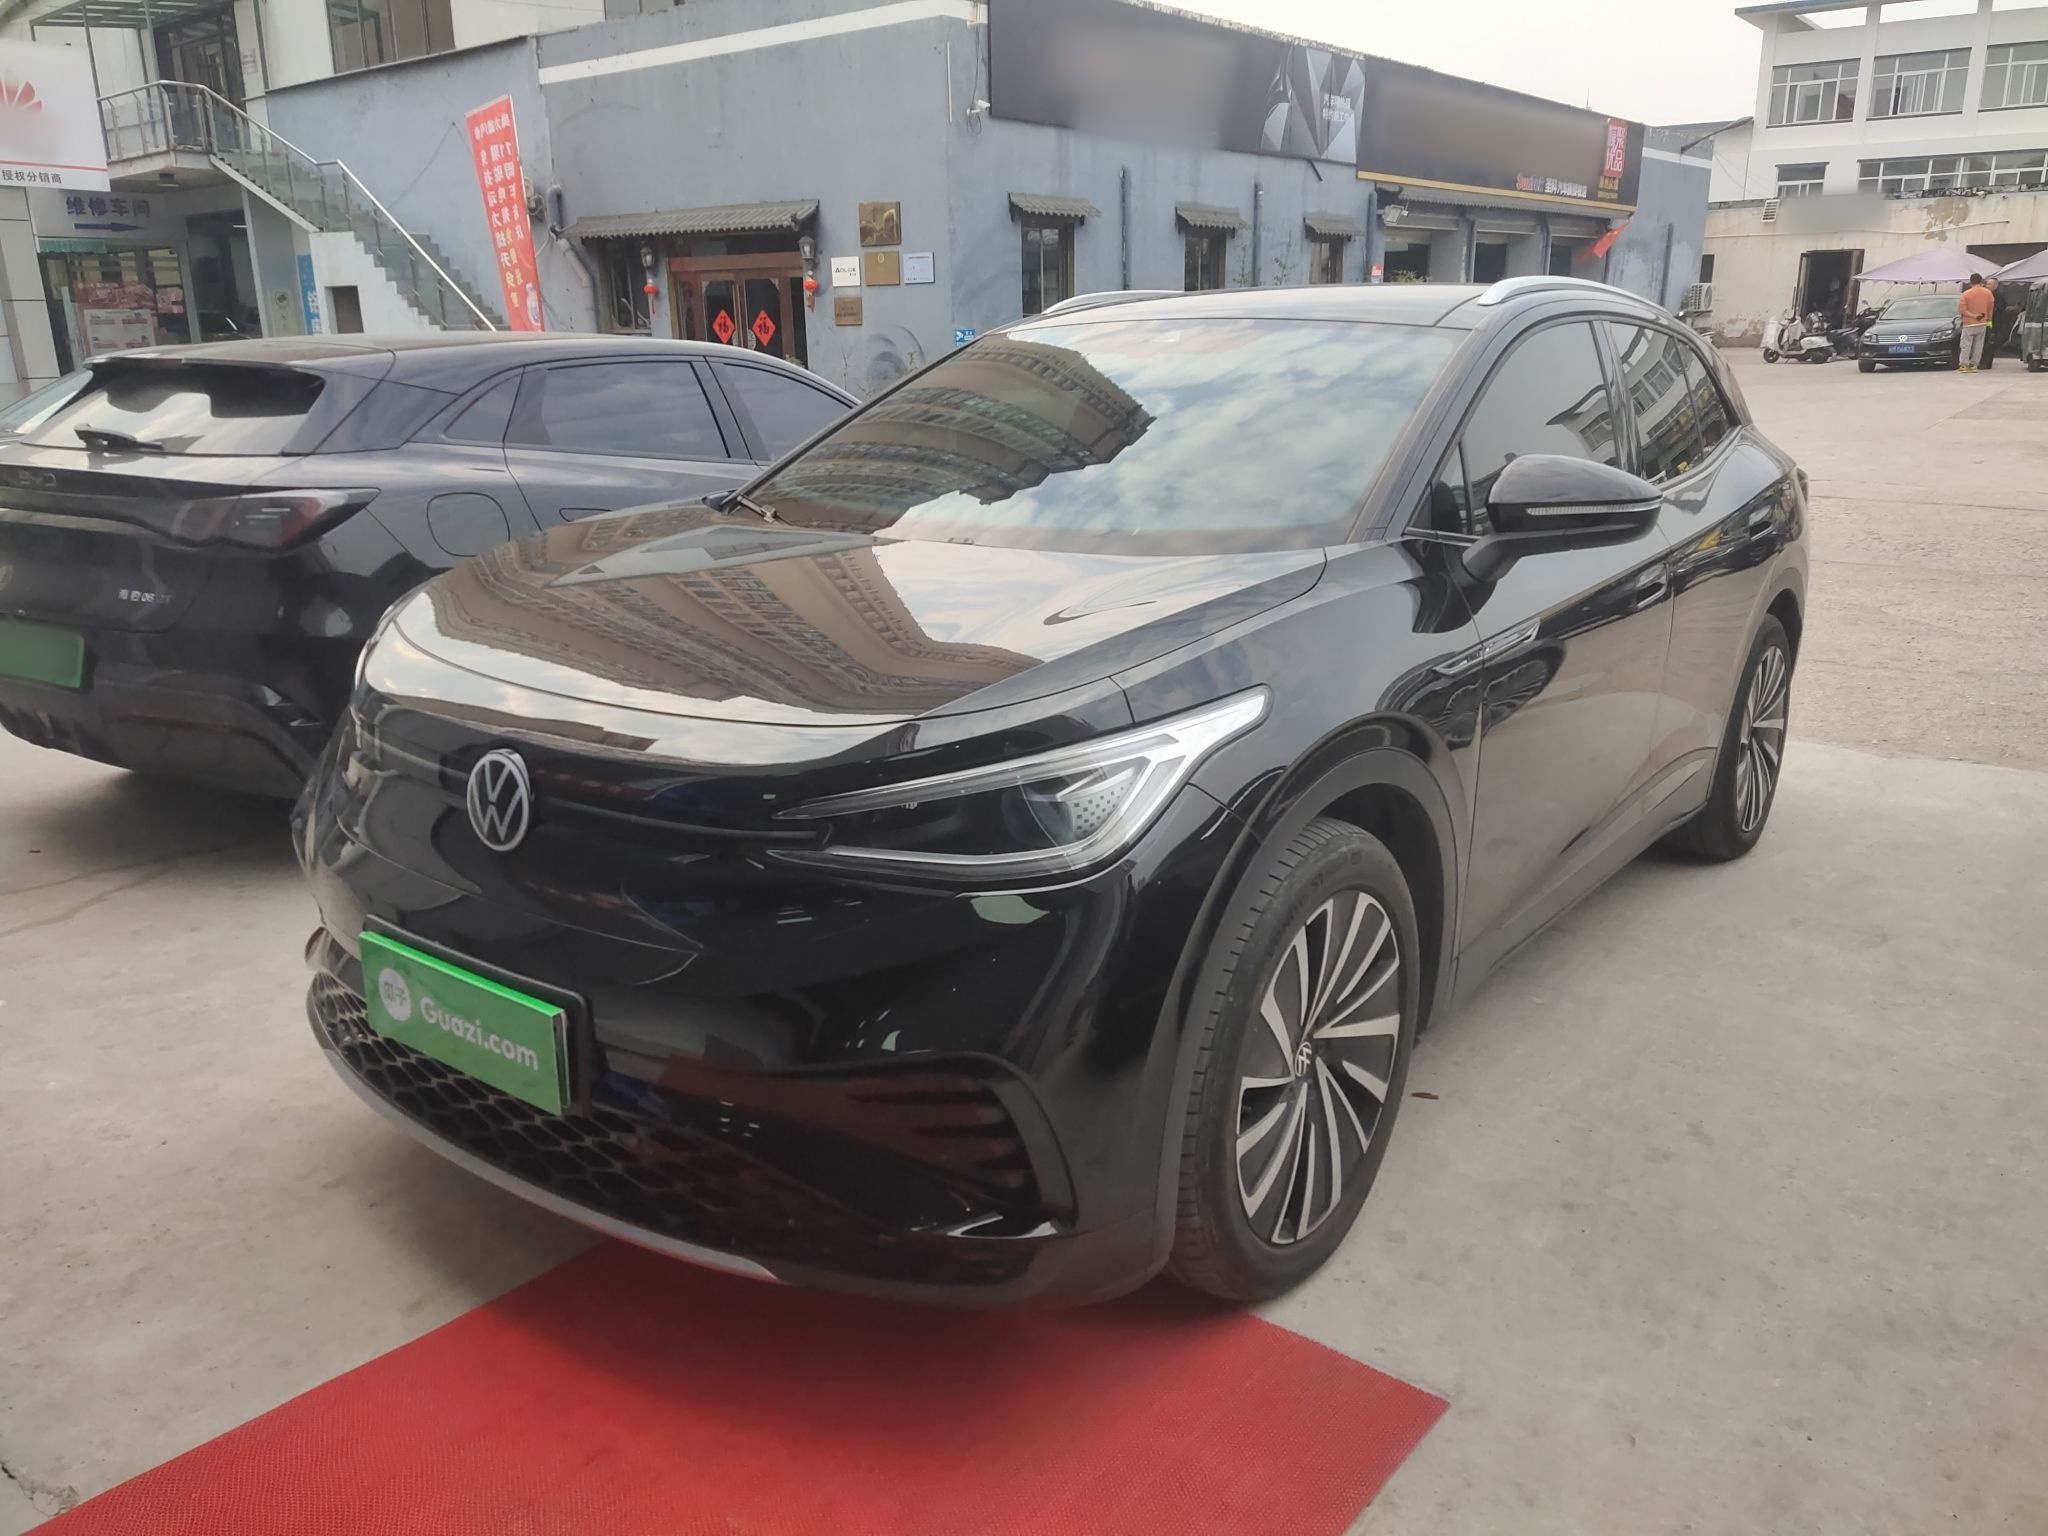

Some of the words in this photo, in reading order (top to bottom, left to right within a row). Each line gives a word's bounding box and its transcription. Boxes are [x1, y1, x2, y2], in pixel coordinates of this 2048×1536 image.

[2, 169, 62, 184] 授权分销商
[66, 196, 150, 217] 维修车间
[419, 996, 539, 1072] Guazi.com
